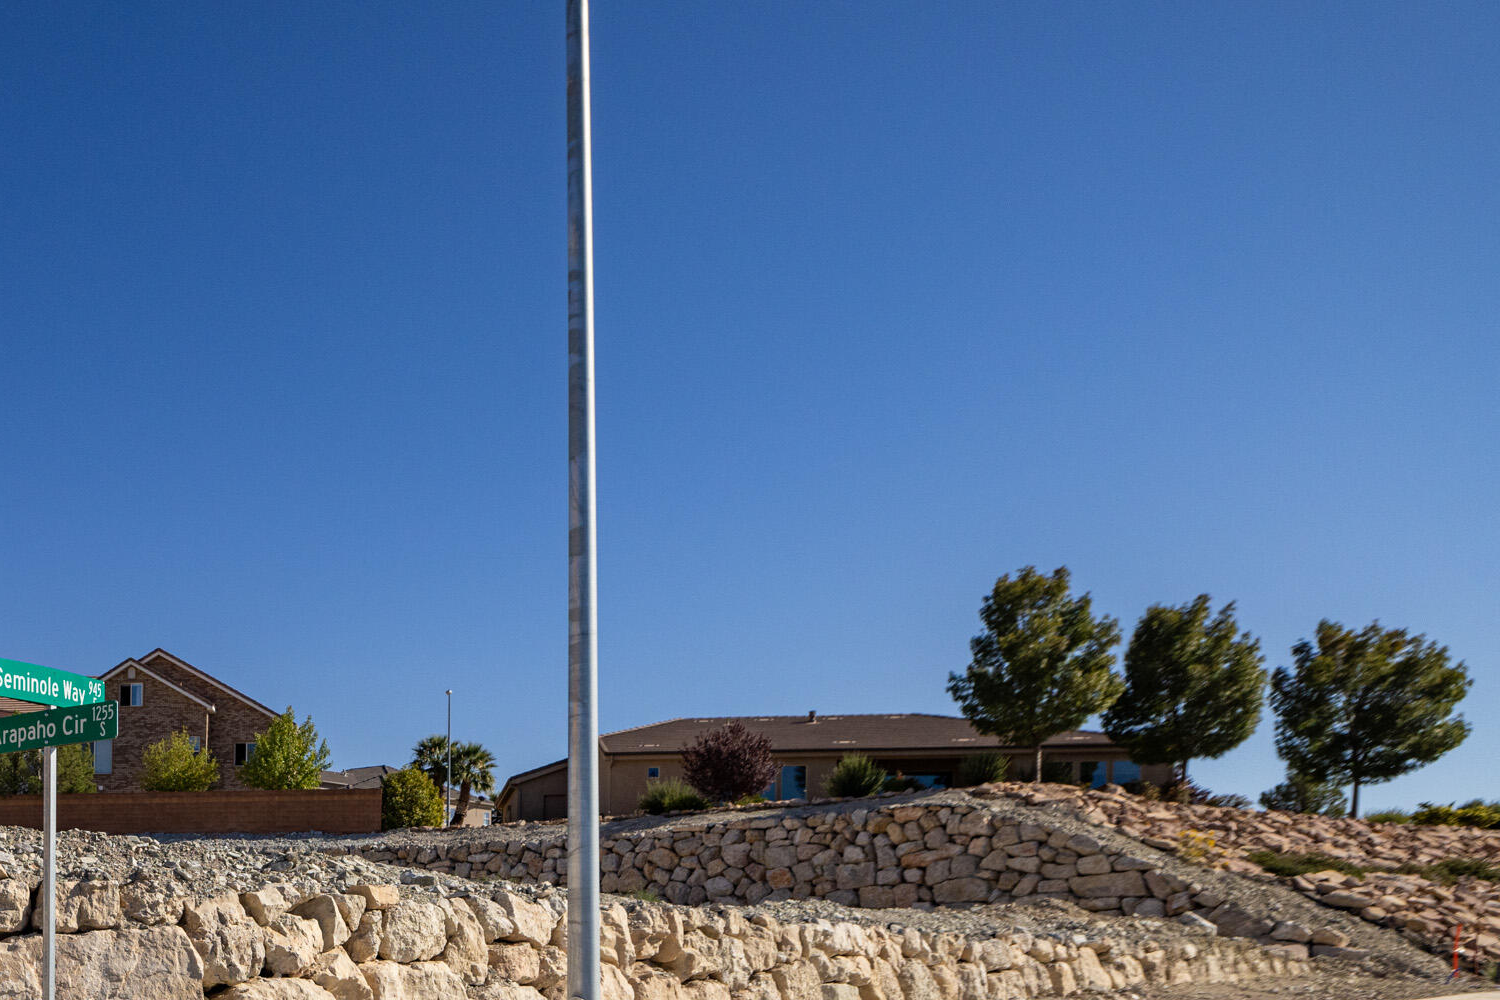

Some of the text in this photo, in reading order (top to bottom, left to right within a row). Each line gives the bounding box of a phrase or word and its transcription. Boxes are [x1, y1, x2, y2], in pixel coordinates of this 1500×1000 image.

[63, 679, 85, 706] Way
[88, 681, 102, 698] 945
[92, 704, 114, 722] 1255
[62, 715, 87, 736] Cir
[100, 721, 106, 737] S
